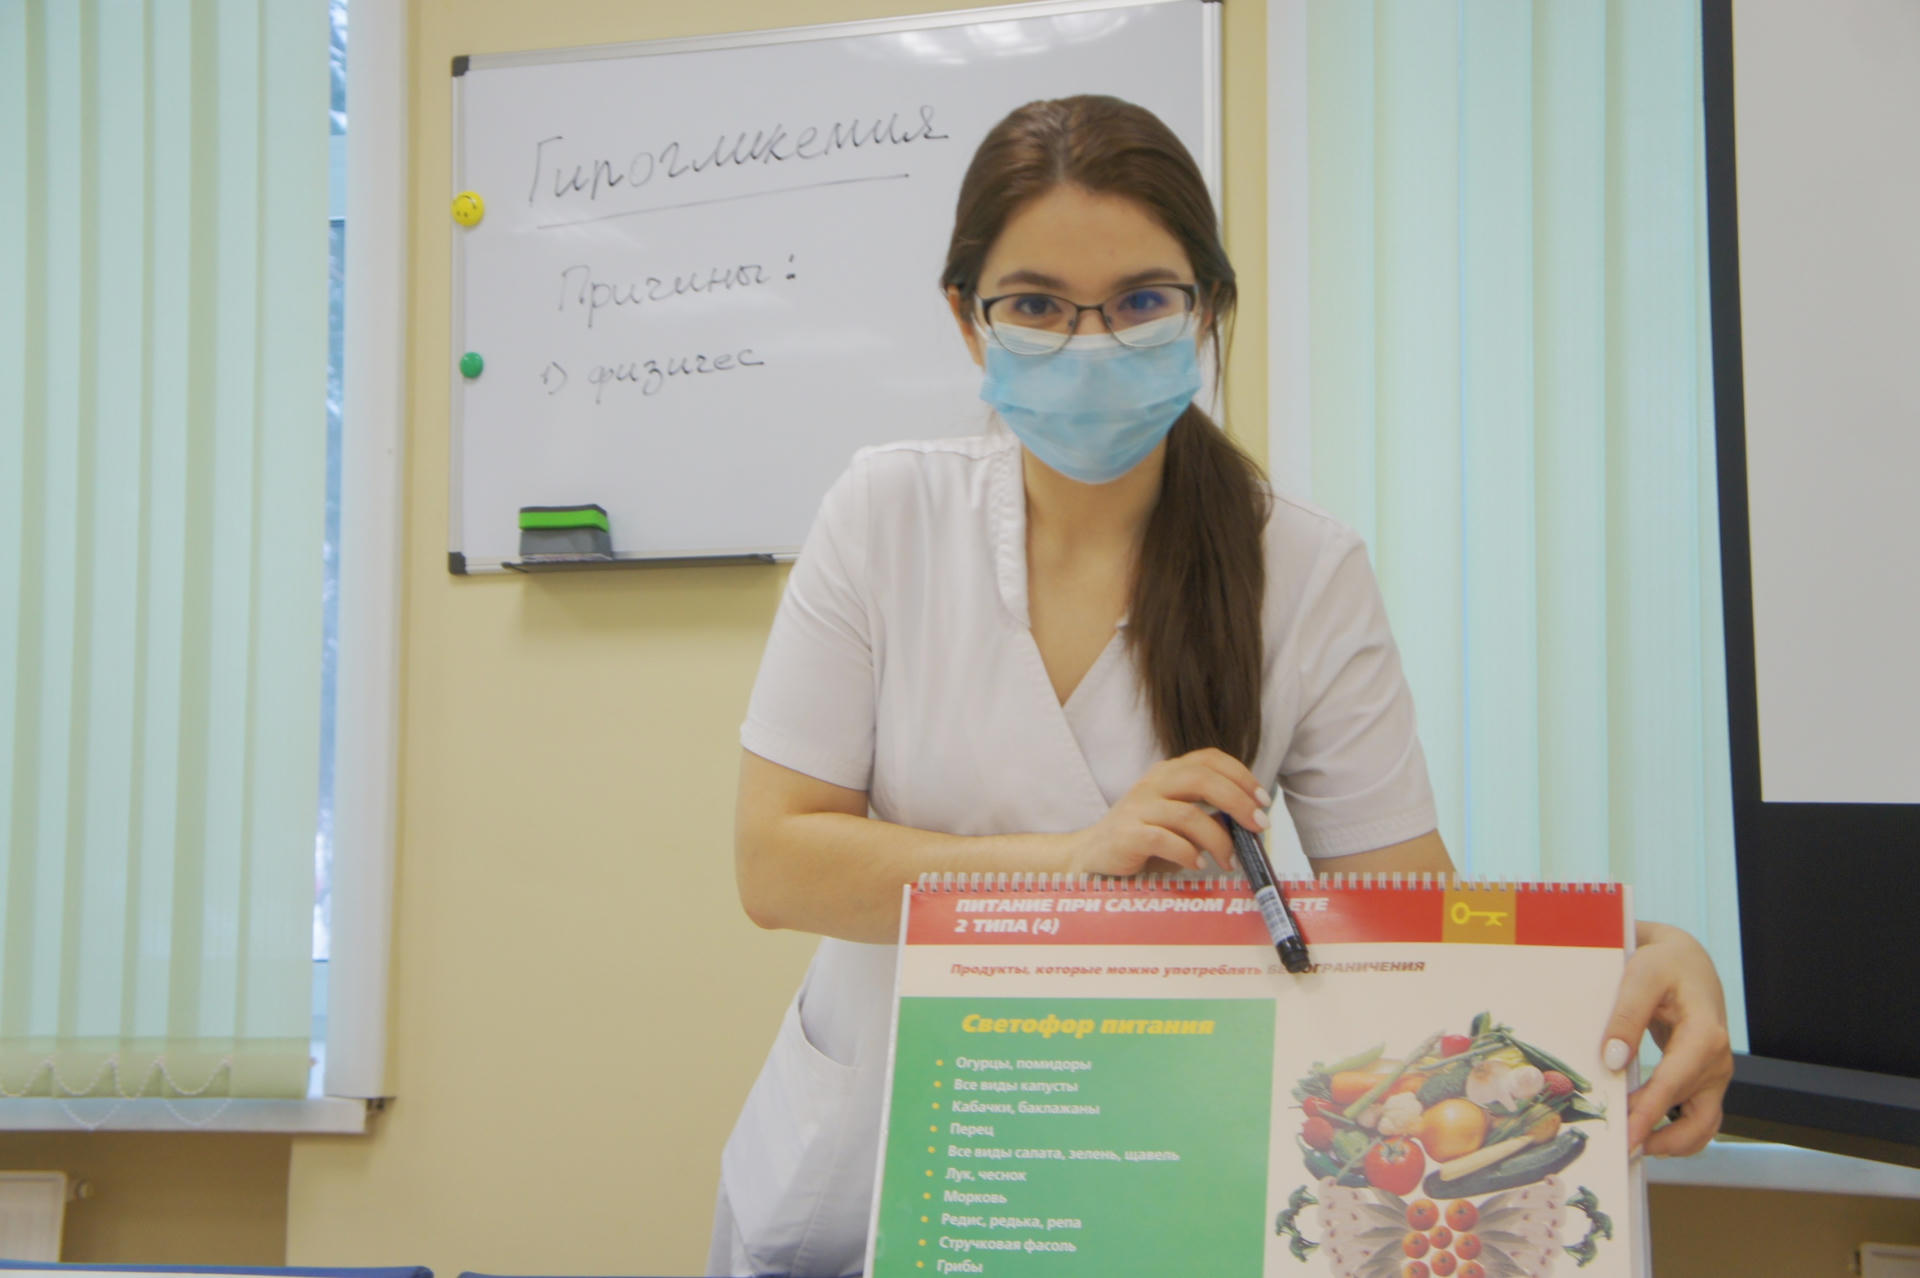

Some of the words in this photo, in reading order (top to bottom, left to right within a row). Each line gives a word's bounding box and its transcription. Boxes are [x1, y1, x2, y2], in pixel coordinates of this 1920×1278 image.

[955, 899, 1053, 912] ПИТАНИЕ
[1056, 899, 1100, 912] ПРИ
[1105, 899, 1224, 912] САХАРНОМ
[1226, 898, 1329, 914] ДИЕТЕ
[954, 919, 967, 933] 2
[973, 919, 1027, 933] ТИПА
[1032, 918, 1060, 935] (4)
[1035, 965, 1103, 976] которые
[1106, 966, 1160, 975] можно
[1162, 964, 1262, 977] употреблять
[1303, 962, 1426, 975] ОГРАНИЧЕНИЯ
[961, 1014, 1095, 1039] Светофор
[1100, 1018, 1215, 1034] питания
[955, 1056, 1013, 1072] Огурцы,
[1016, 1059, 1092, 1072] помидоры
[953, 1079, 978, 1091] Все
[980, 1081, 1018, 1093] виды
[1020, 1080, 1079, 1095] капусты
[952, 1101, 1015, 1115] Кабачки,
[1018, 1101, 1100, 1115] баклажаны
[949, 1123, 994, 1138] Перец
[948, 1145, 972, 1157] Все
[974, 1147, 1012, 1160] виды
[1015, 1148, 1066, 1161] салата,
[1068, 1150, 1121, 1162] зелень,
[1124, 1150, 1181, 1163] щавель
[945, 1168, 975, 1183] Лук,
[978, 1171, 1026, 1181] чеснок
[943, 1190, 1008, 1206] Морковь
[941, 1213, 987, 1228] Редис,
[989, 1216, 1044, 1230] редька,
[1047, 1218, 1082, 1231] репа
[938, 1236, 1022, 1252] Стручковая
[1024, 1239, 1077, 1254] фасоль
[937, 1259, 984, 1275] Грибы
